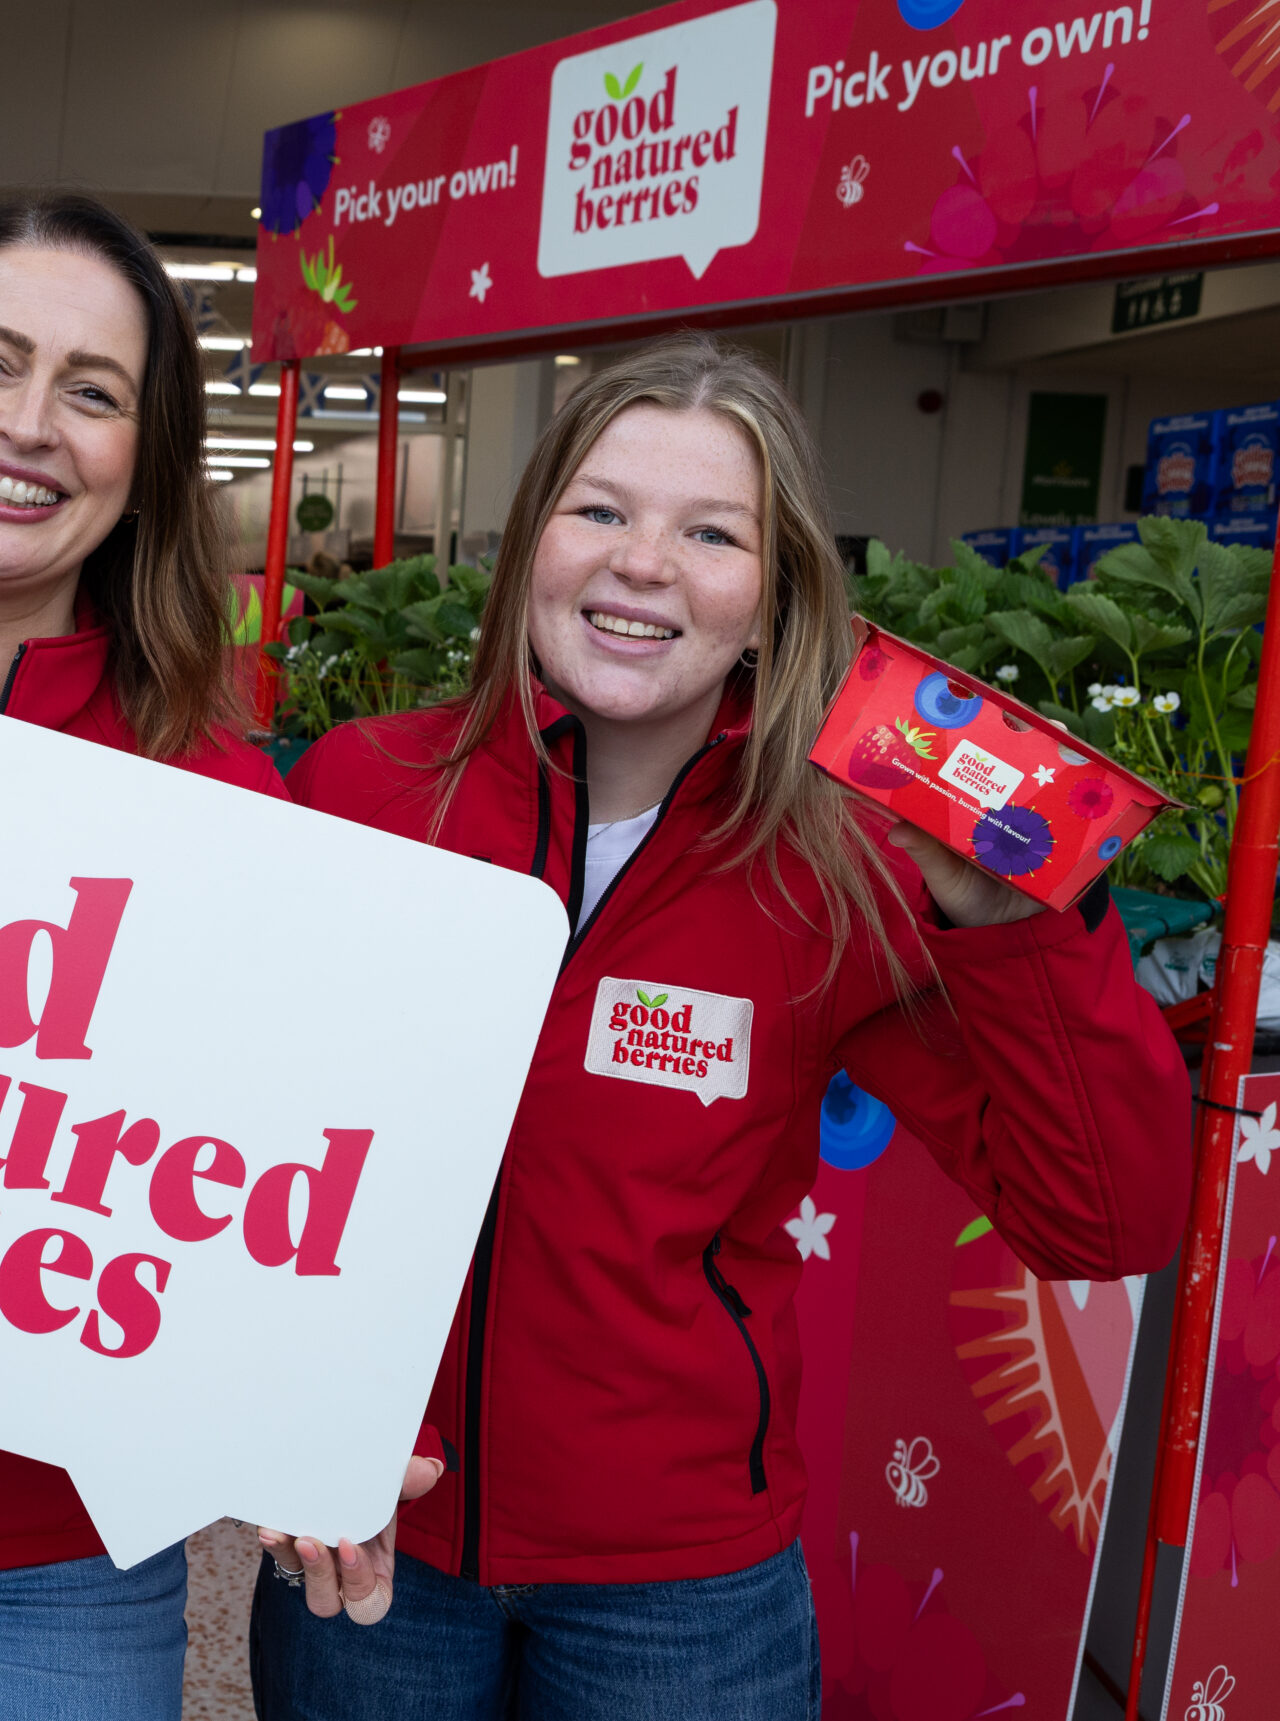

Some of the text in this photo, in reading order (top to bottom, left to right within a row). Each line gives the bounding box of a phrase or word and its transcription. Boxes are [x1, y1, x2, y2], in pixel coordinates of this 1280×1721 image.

[805, 0, 1153, 118] Pick your own!
[568, 64, 677, 170] good
[590, 105, 739, 191] natured
[334, 144, 519, 226] Pick your own!
[573, 176, 699, 234] berries
[952, 767, 991, 796] berries
[957, 753, 995, 777] good
[962, 765, 1007, 794] natured
[891, 758, 1032, 845] Grown with passion, bursting with flavour!
[609, 1002, 693, 1033] good
[612, 1038, 708, 1078] berries
[627, 1028, 733, 1062] natured
